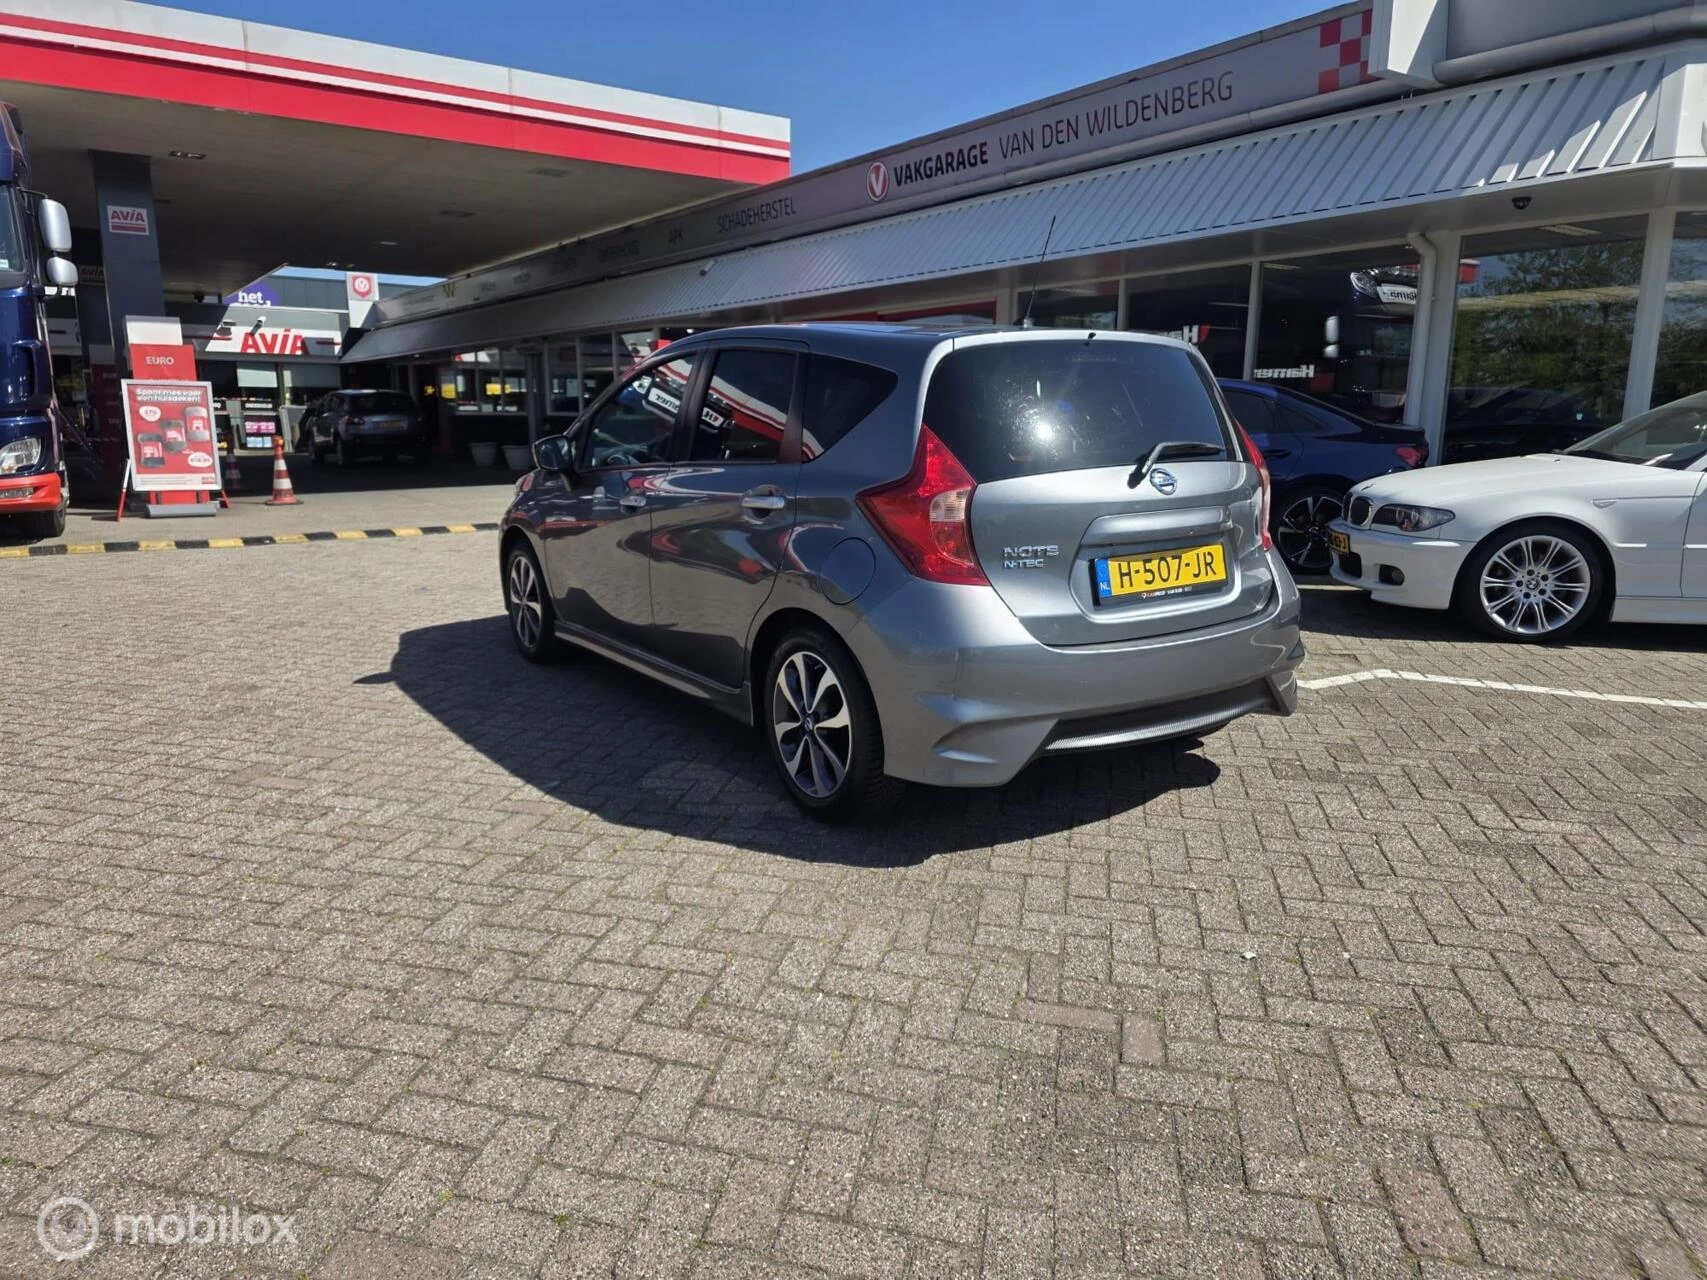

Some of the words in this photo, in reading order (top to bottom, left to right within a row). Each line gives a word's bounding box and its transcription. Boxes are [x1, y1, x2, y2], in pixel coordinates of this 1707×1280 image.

[894, 141, 988, 187] VAKGARAGE
[999, 128, 1034, 160] VAN
[1041, 117, 1079, 146] DEN
[1086, 71, 1233, 135] WILDENBERG
[111, 209, 145, 222] AVIA
[717, 196, 797, 233] SCHADEHERSTEL
[238, 289, 264, 304] het
[240, 328, 310, 355] AVIA
[146, 356, 175, 366] EURO
[1004, 559, 1044, 568] N-TEC
[1117, 551, 1217, 588] H-507-JR
[1100, 582, 1110, 590] NL
